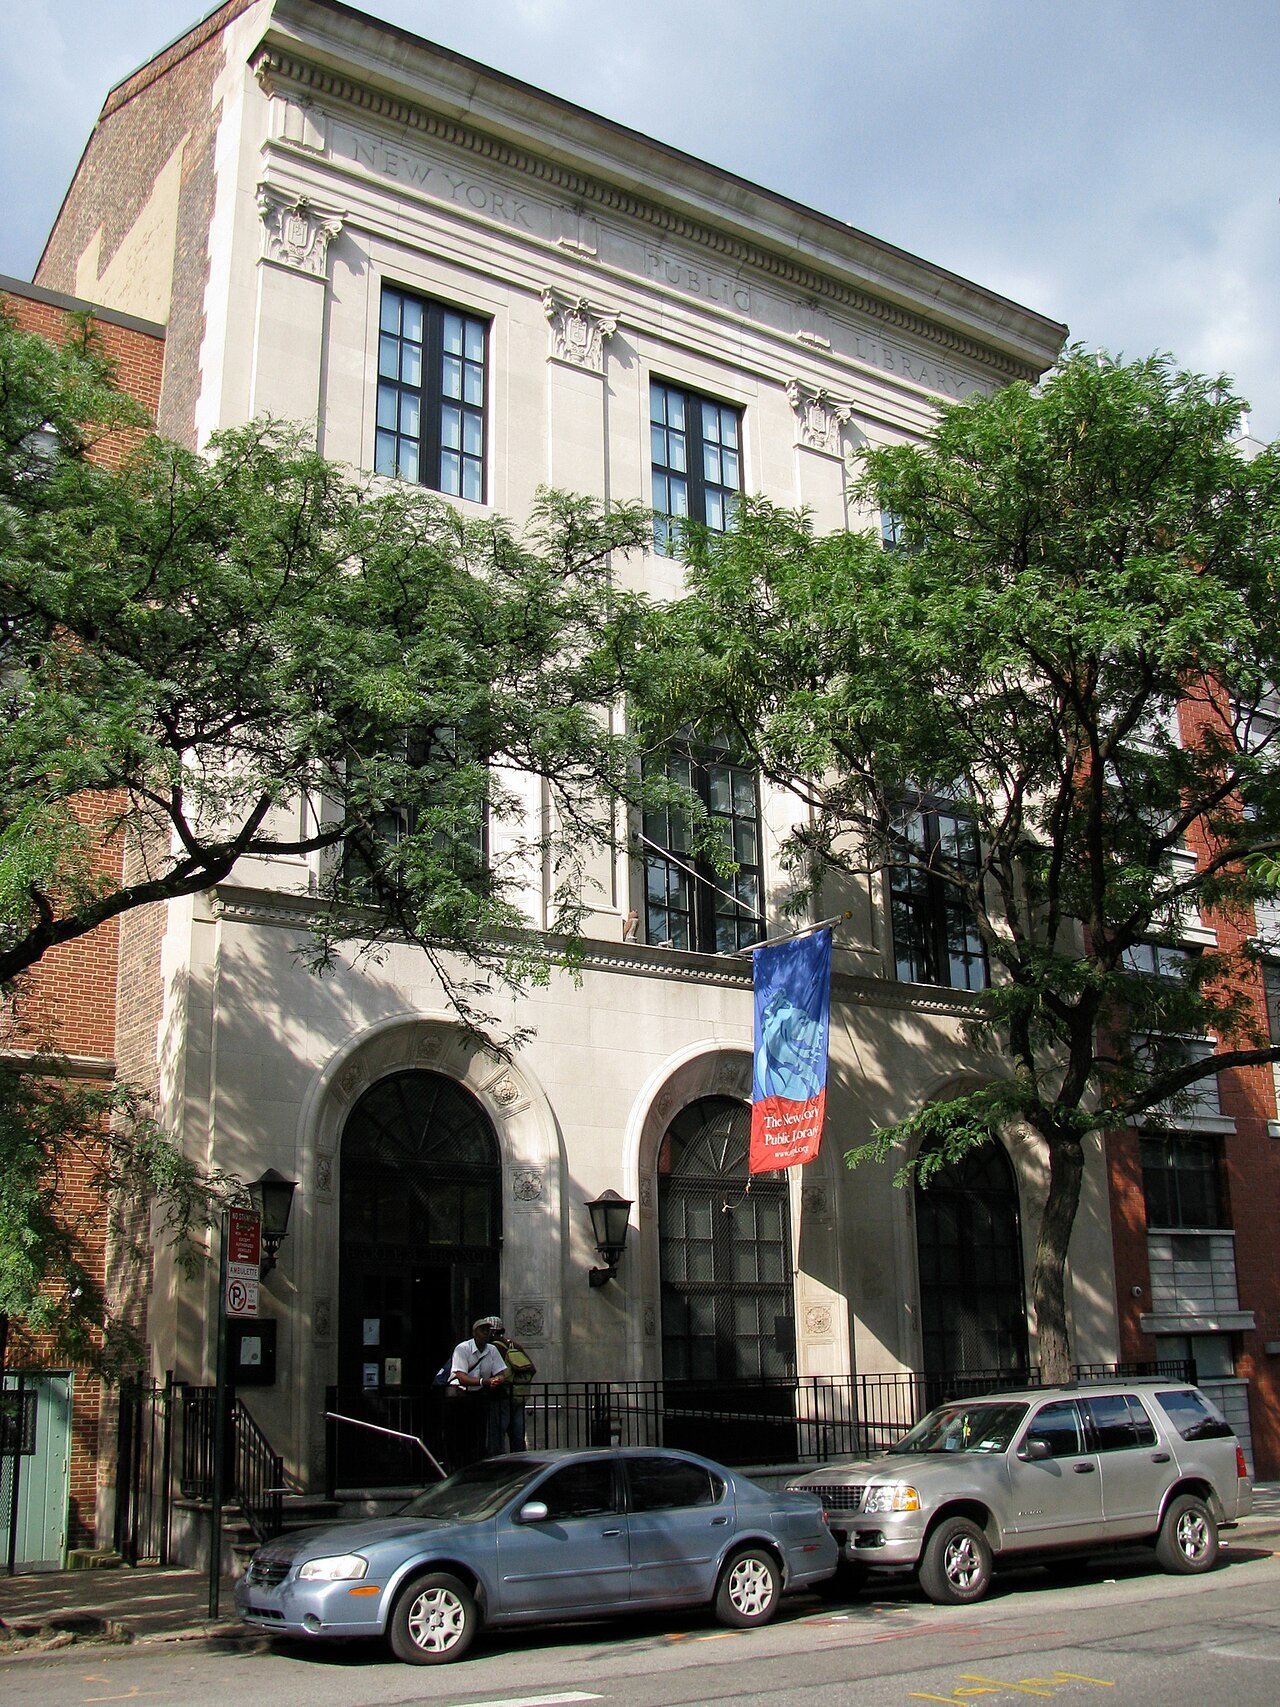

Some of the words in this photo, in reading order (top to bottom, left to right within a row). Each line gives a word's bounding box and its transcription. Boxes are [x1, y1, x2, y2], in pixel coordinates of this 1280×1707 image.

[352, 138, 433, 185] NEW
[441, 173, 533, 229] YORK
[646, 253, 750, 312] PUBLIC
[854, 337, 967, 397] LIBRARY
[763, 1115, 783, 1129] The
[782, 1112, 802, 1126] New
[764, 1131, 791, 1146] Public
[791, 1125, 819, 1142] Lbrary
[230, 1266, 258, 1277] AMBULETTE
